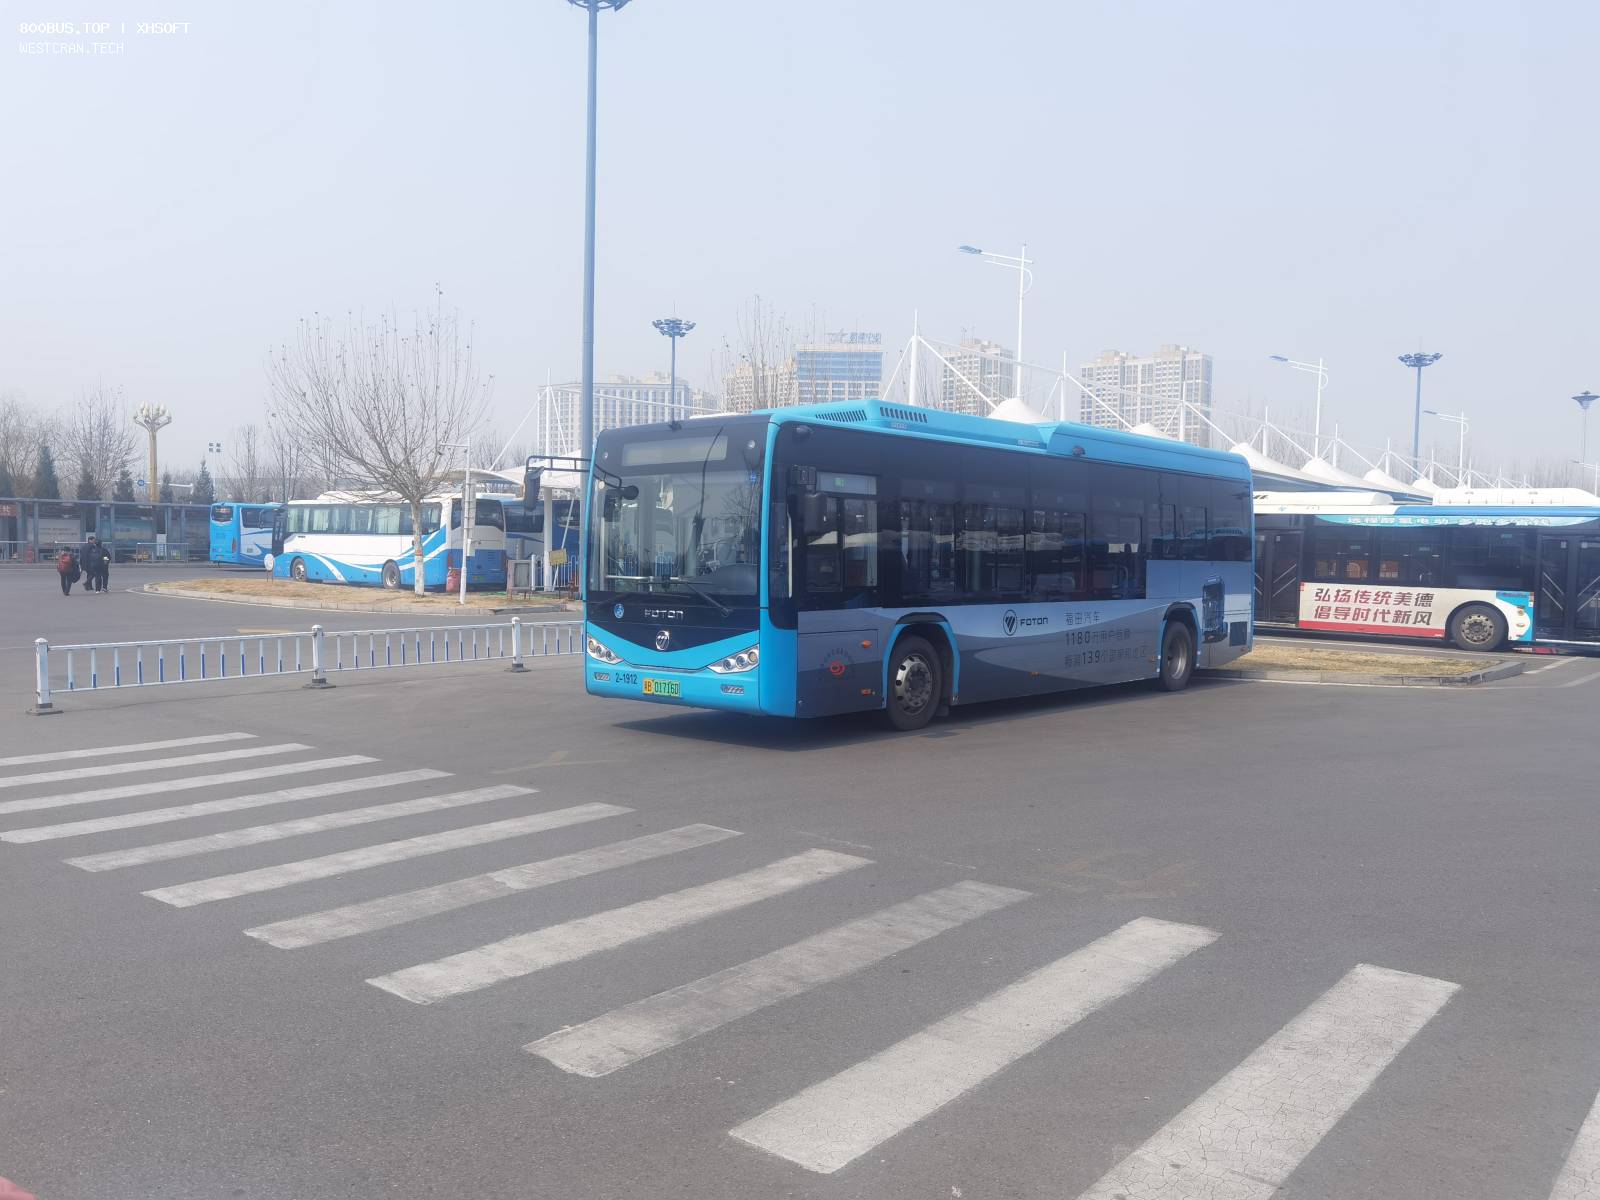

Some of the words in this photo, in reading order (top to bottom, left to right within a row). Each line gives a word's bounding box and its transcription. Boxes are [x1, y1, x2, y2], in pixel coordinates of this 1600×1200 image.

[1314, 588, 1434, 608] 弘扬传统美德
[644, 609, 684, 619] FOTON
[1314, 605, 1432, 625] 倡导时代新风
[1020, 617, 1048, 627] FOTON
[615, 672, 638, 685] 2-1912
